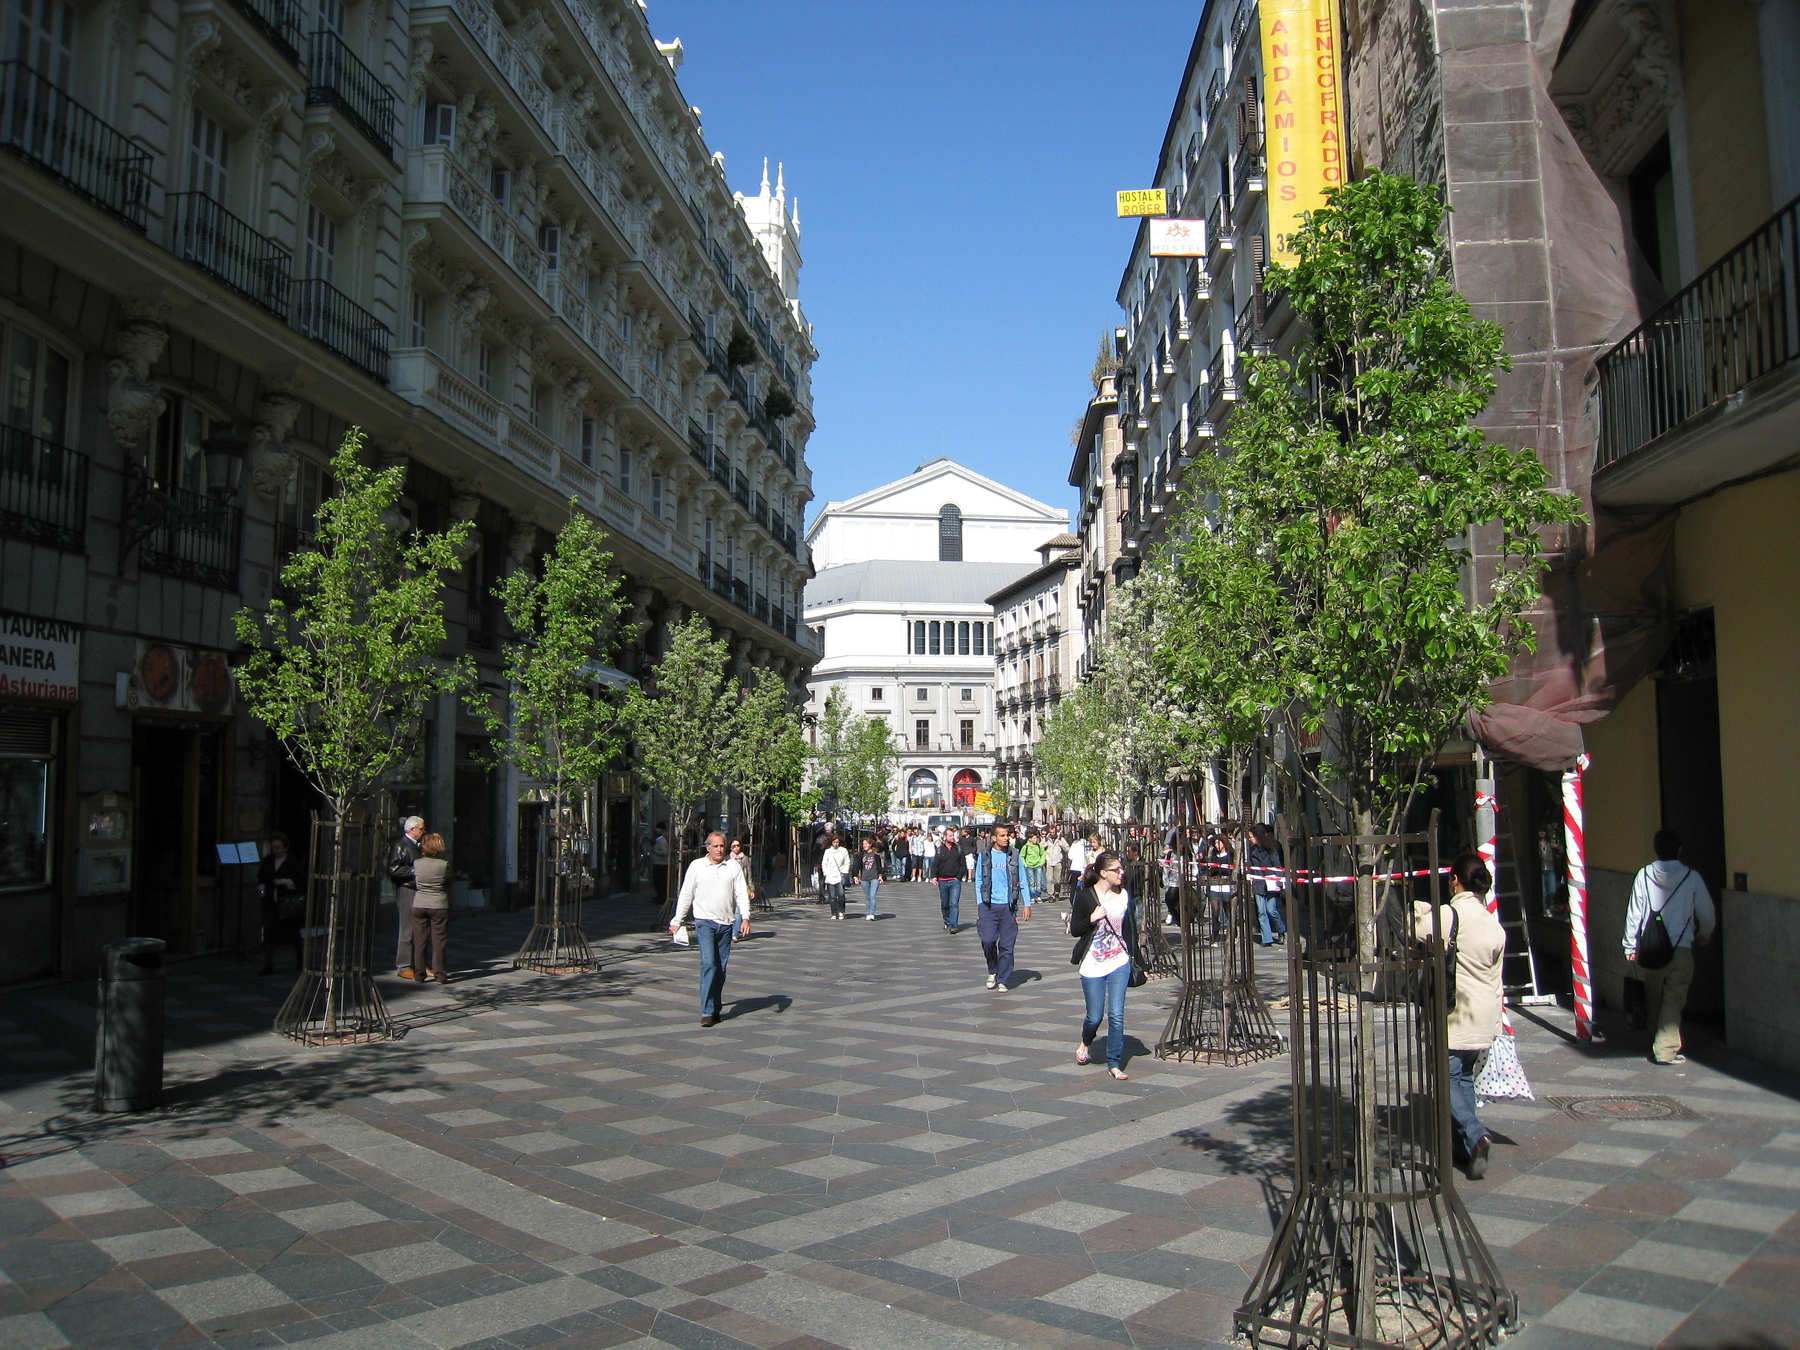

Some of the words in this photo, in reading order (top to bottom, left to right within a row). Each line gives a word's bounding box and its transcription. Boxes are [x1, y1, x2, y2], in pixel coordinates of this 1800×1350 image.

[1270, 20, 1297, 201] ANDAMIOS
[1316, 19, 1340, 199] ENCOFRADO
[1119, 191, 1153, 202] HOSTAL
[1124, 204, 1161, 215] ROBER
[0, 674, 77, 700] Asturiana
